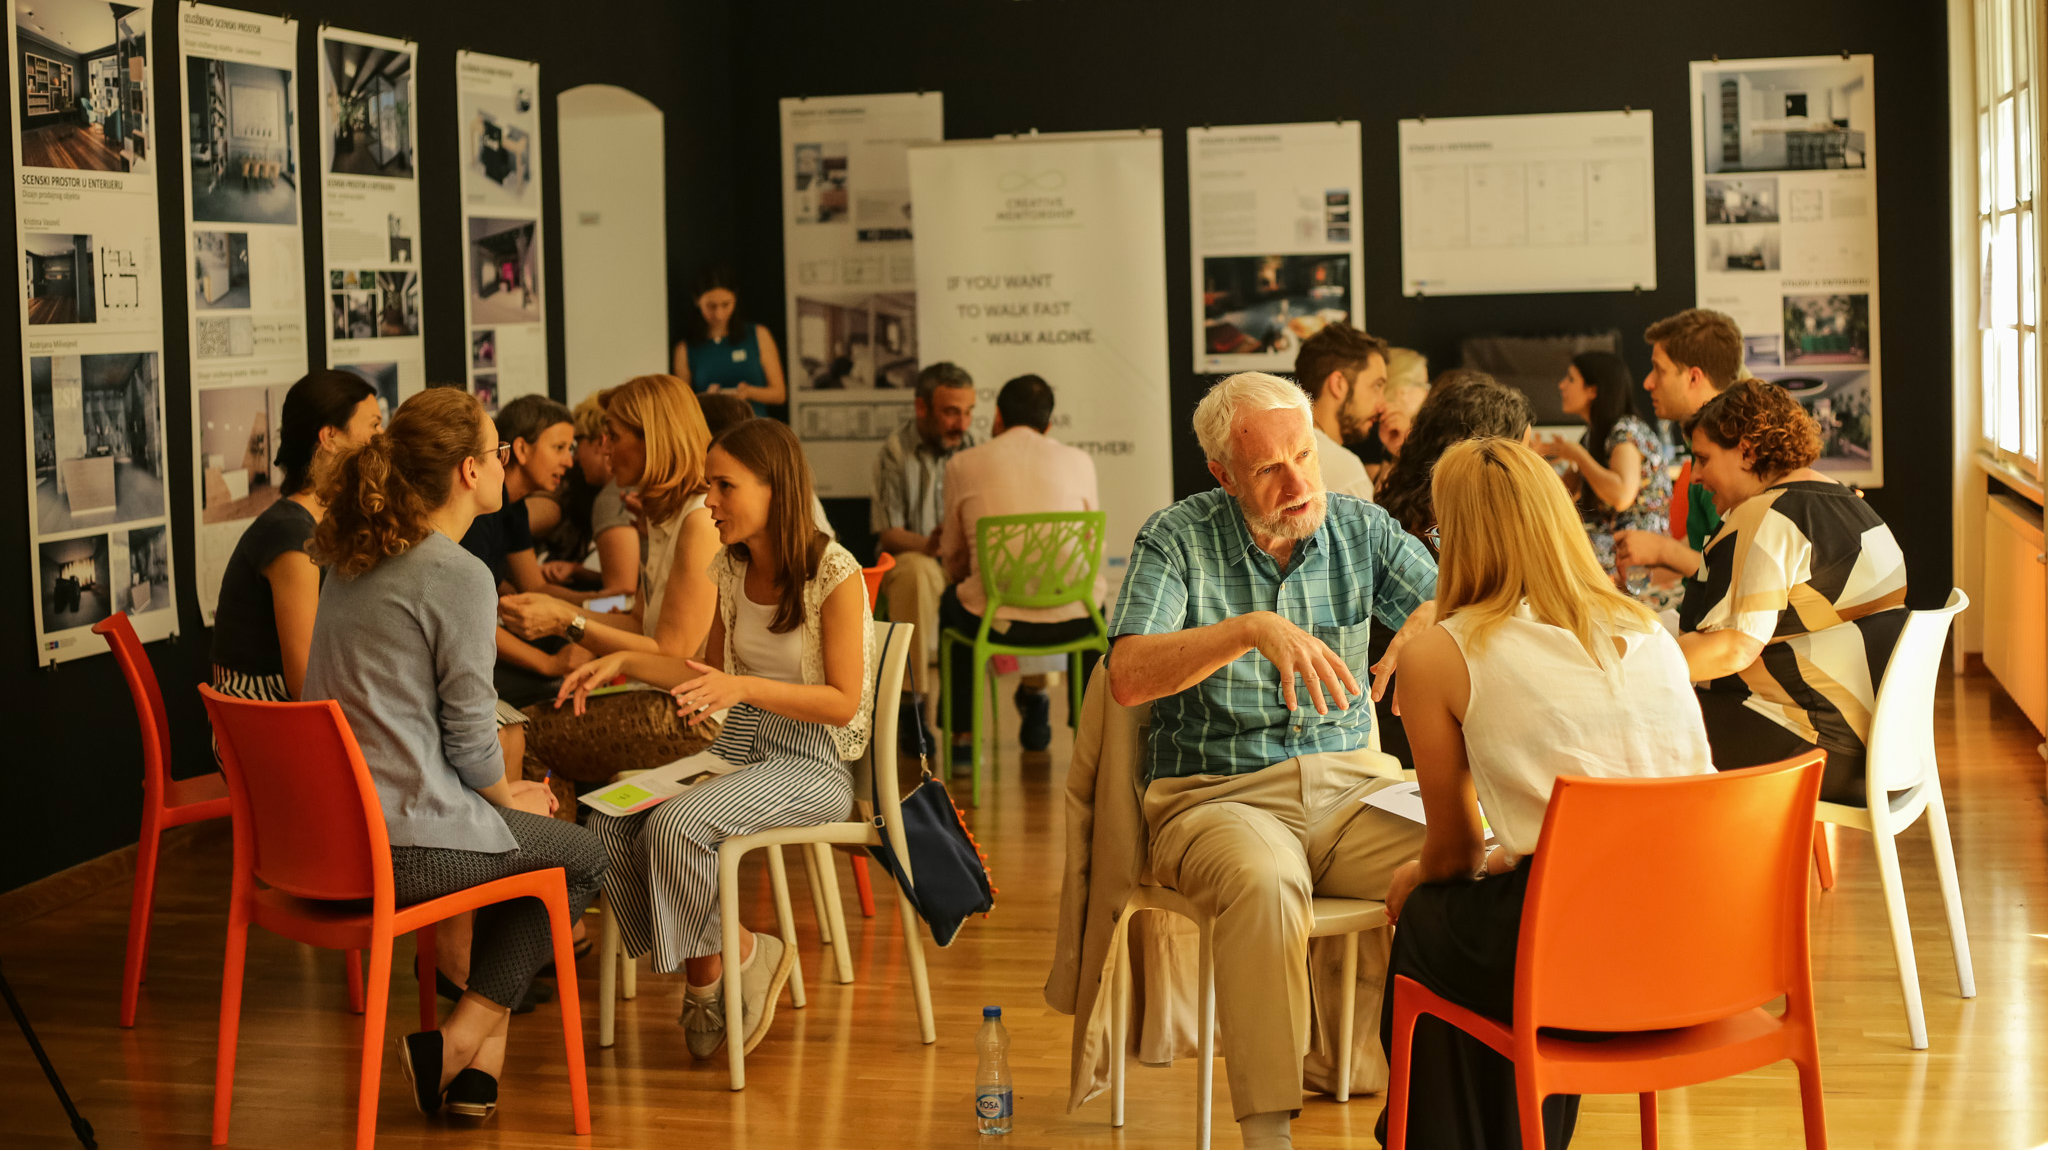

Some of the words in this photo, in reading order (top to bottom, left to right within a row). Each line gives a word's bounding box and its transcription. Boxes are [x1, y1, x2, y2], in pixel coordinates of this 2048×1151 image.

[22, 174, 50, 186] SCENSKI
[51, 176, 80, 188] PROSTOR
[81, 179, 87, 188] U
[946, 276, 960, 290] IF
[965, 275, 999, 290] YOU
[1003, 273, 1054, 288] WANT
[957, 303, 981, 318] TO
[984, 302, 1029, 317] WALK
[1033, 301, 1072, 316] FAST
[986, 331, 1033, 346] WALK
[979, 1100, 999, 1109] ROSA
